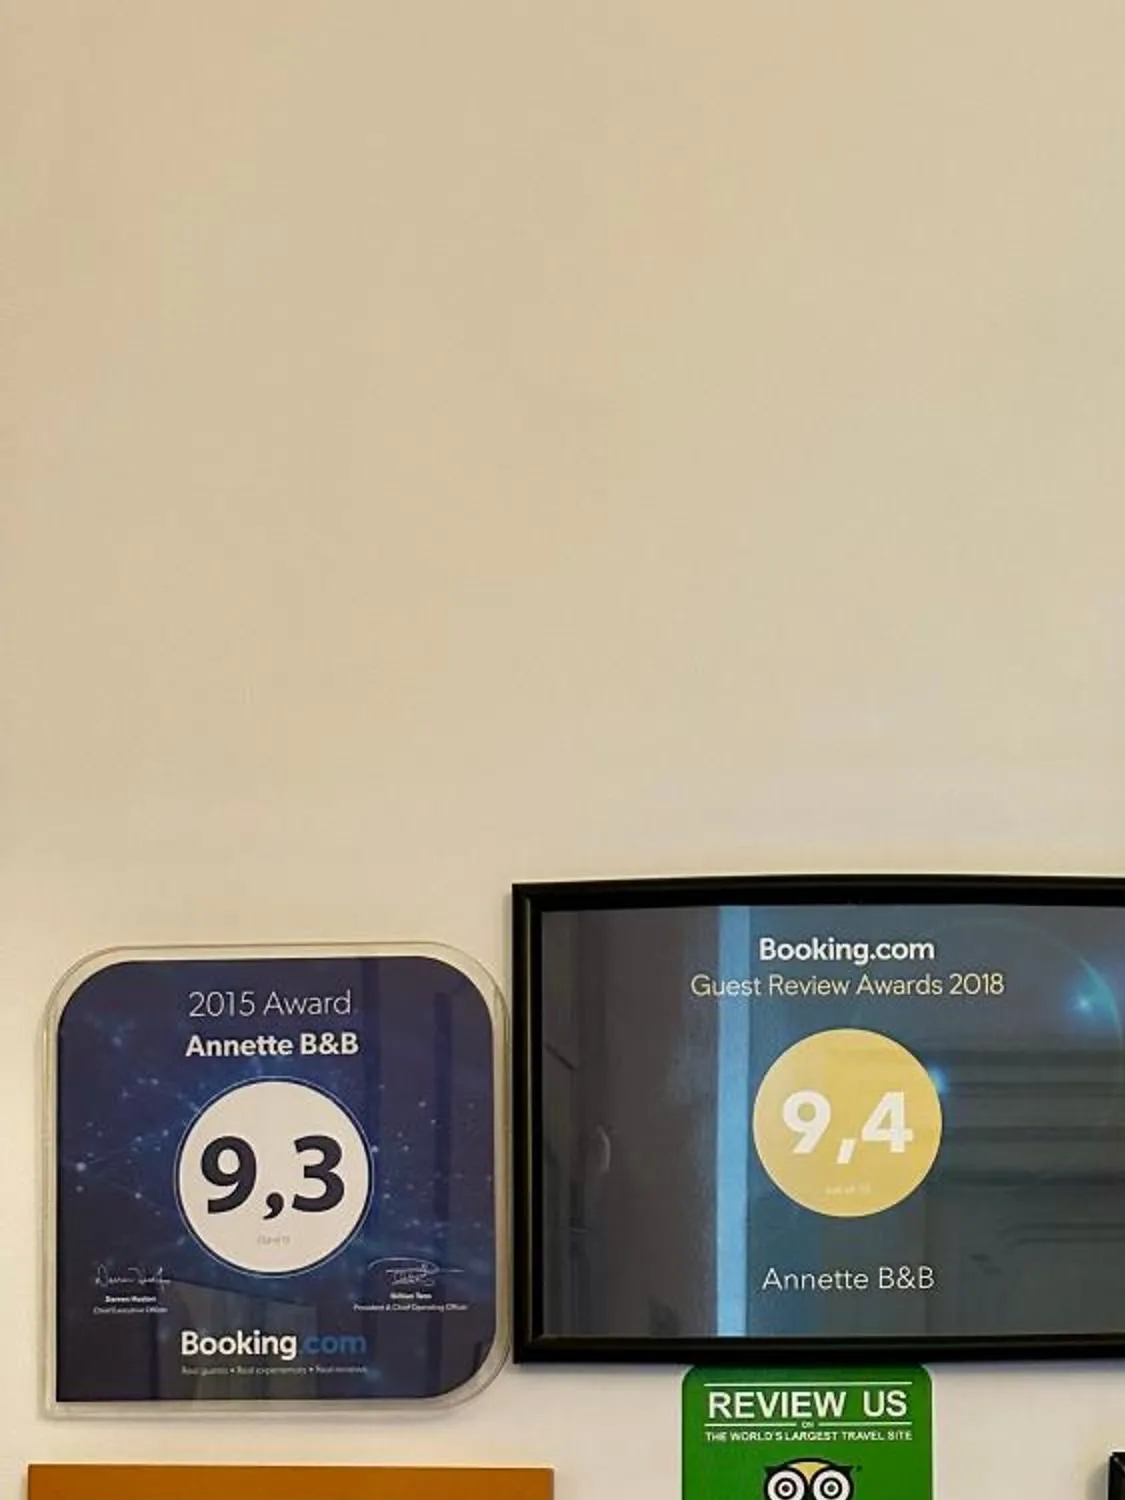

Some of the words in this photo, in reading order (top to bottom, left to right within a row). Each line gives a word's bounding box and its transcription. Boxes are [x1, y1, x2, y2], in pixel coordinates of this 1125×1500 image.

[759, 937, 935, 965] Booking.com
[691, 973, 761, 997] Guest
[768, 972, 848, 996] Review
[856, 973, 942, 996] Awards
[949, 973, 1004, 996] 2018
[188, 991, 256, 1018] 2015
[263, 990, 352, 1016] Award
[186, 1034, 293, 1057] Annette
[300, 1032, 359, 1056] B&B
[782, 1090, 913, 1164] 9,4
[200, 1135, 345, 1221] 9,3
[762, 1268, 869, 1290] Annette
[878, 1267, 935, 1289] B&B
[181, 1330, 367, 1360] Booking.com
[708, 1391, 846, 1419] REVIEW
[863, 1390, 907, 1417] US
[706, 1431, 727, 1441] THE
[731, 1431, 783, 1441] WORLD'S
[784, 1431, 840, 1441] LARGEST
[842, 1431, 884, 1441] TRAVEL
[888, 1431, 912, 1440] SITE
